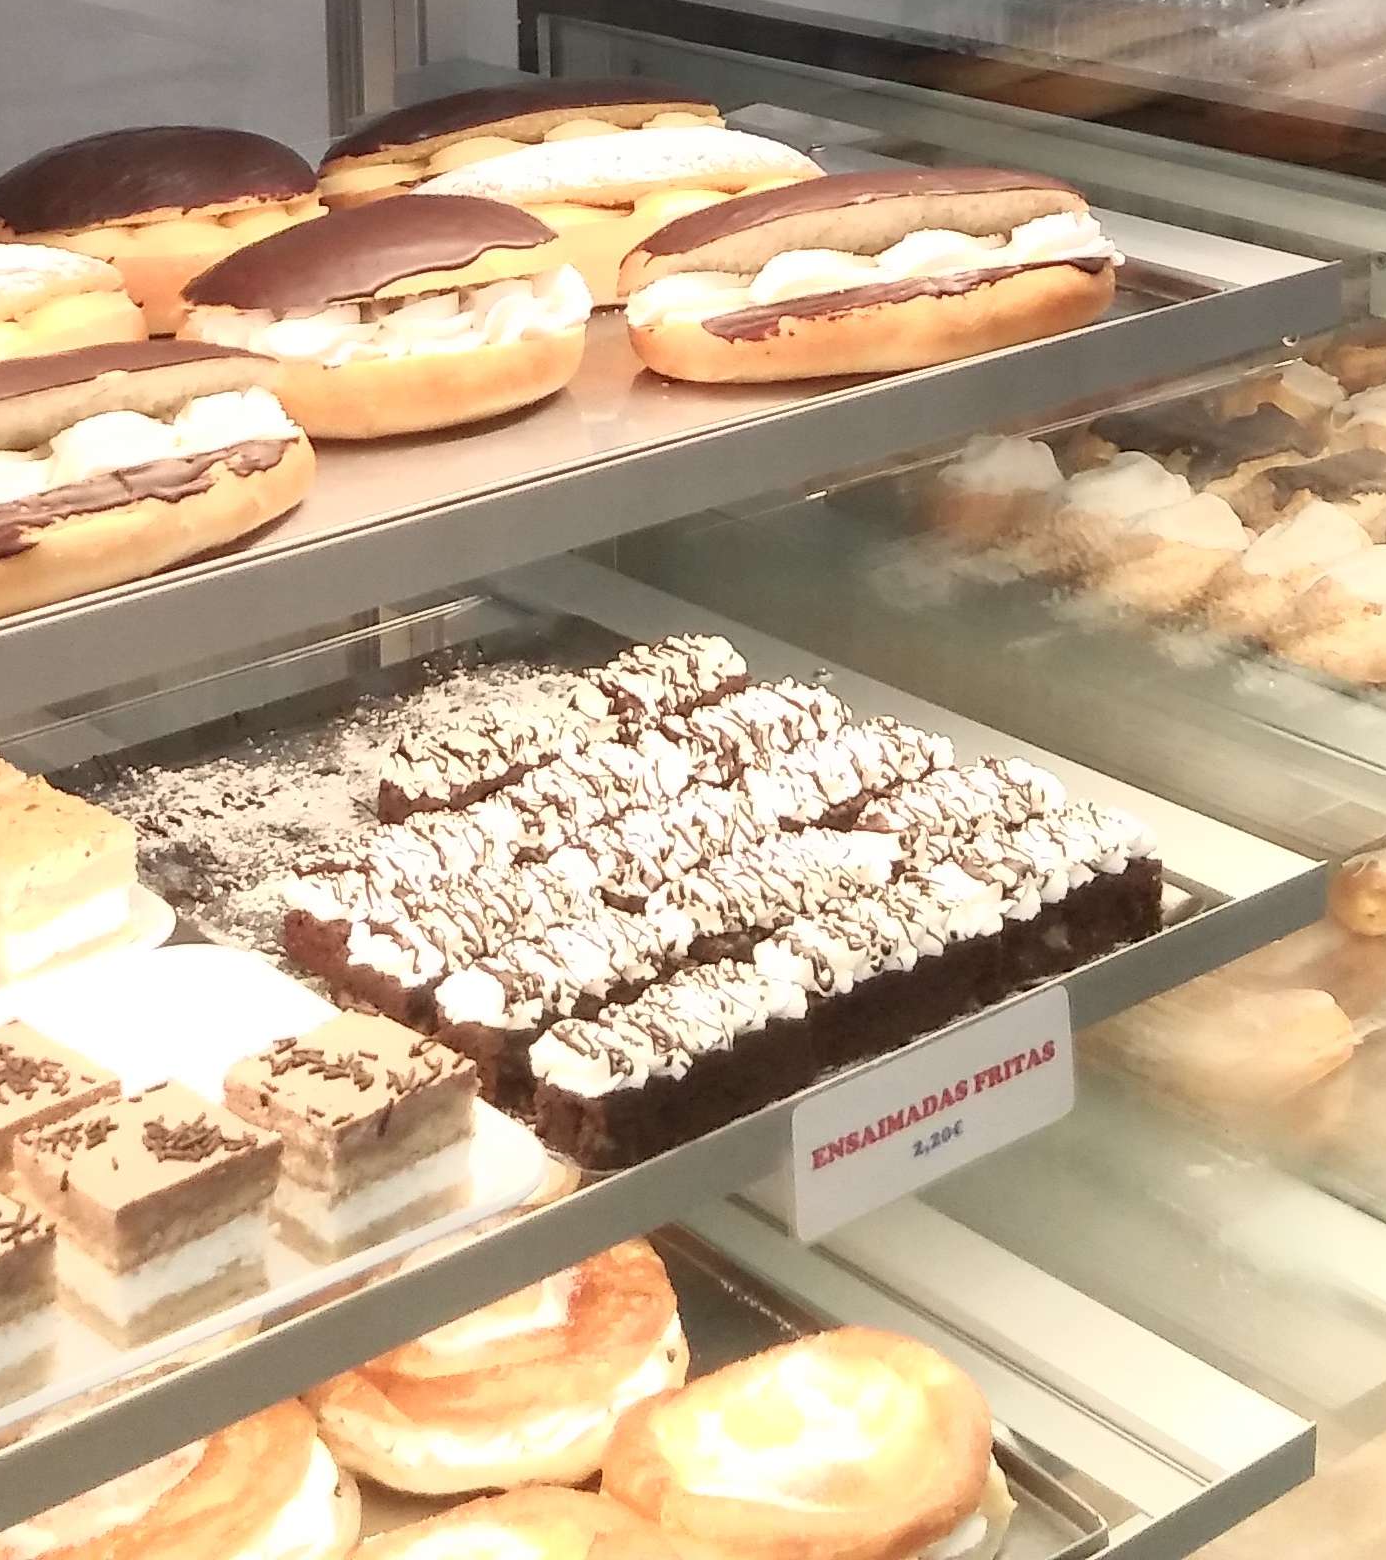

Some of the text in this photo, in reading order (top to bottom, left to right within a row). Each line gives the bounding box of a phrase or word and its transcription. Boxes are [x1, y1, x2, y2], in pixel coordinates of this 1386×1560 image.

[812, 1039, 1056, 1171] ENSAIMADAS FRITAS
[912, 1119, 964, 1158] 2,20€
